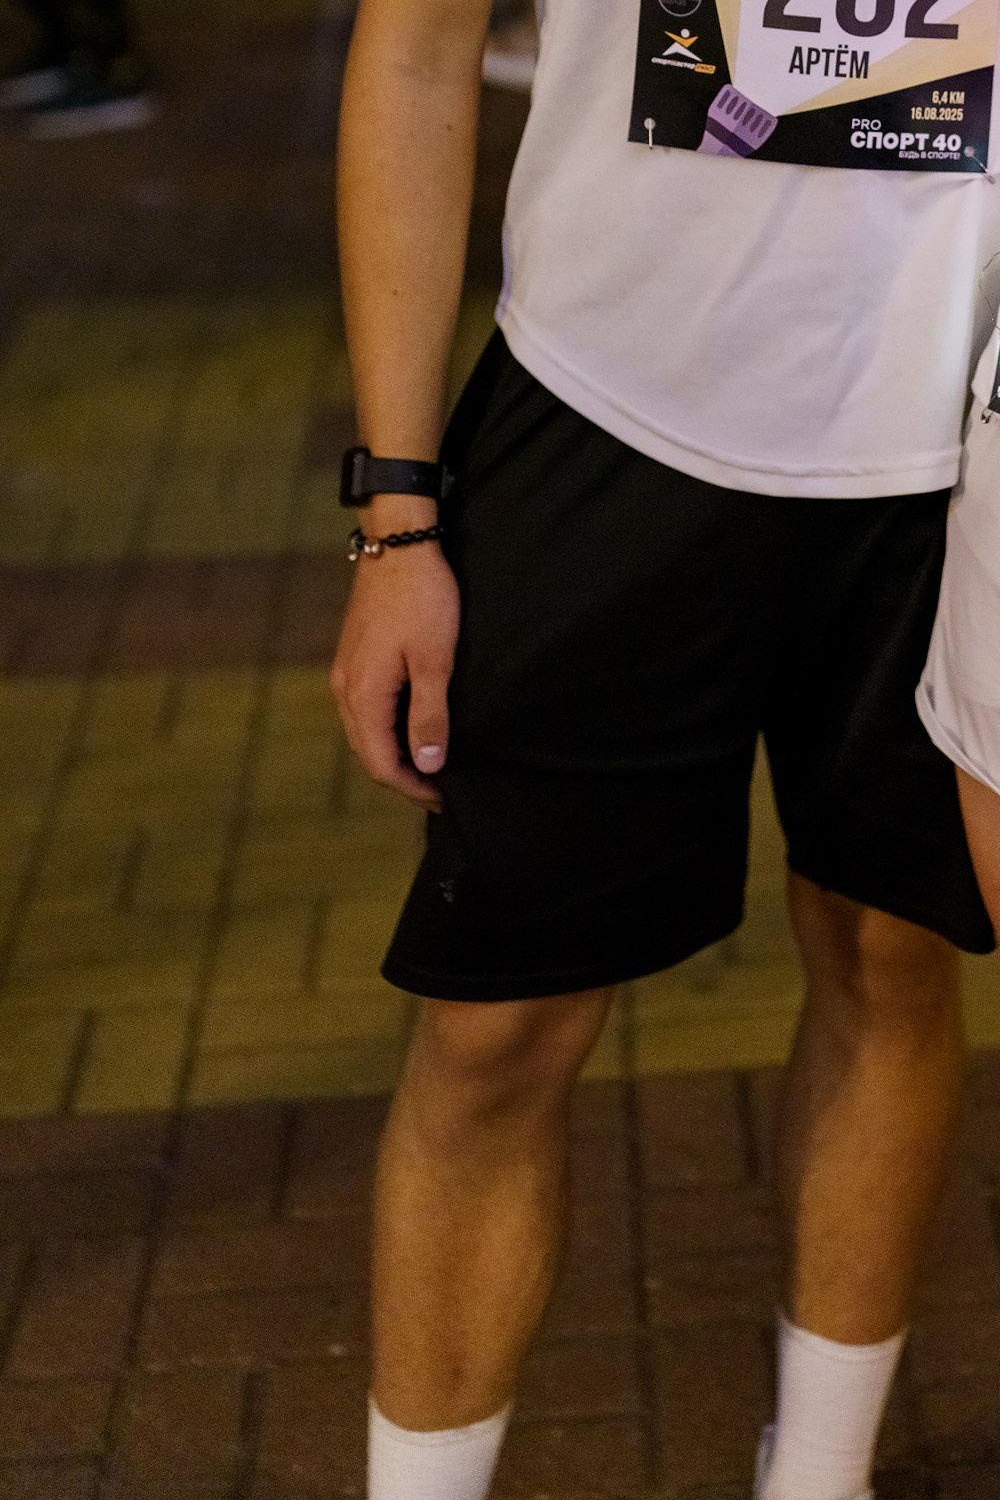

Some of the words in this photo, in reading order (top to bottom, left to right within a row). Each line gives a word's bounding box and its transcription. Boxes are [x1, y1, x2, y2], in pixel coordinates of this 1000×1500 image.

[788, 44, 870, 79] АРТЁМ
[932, 90, 948, 105] 6,4
[911, 106, 964, 121] 16.08.2025
[851, 118, 882, 131] PRO
[850, 131, 930, 151] СПОРТ
[932, 133, 962, 152] 40
[898, 151, 920, 160] БУДЬ
[920, 151, 927, 160] В
